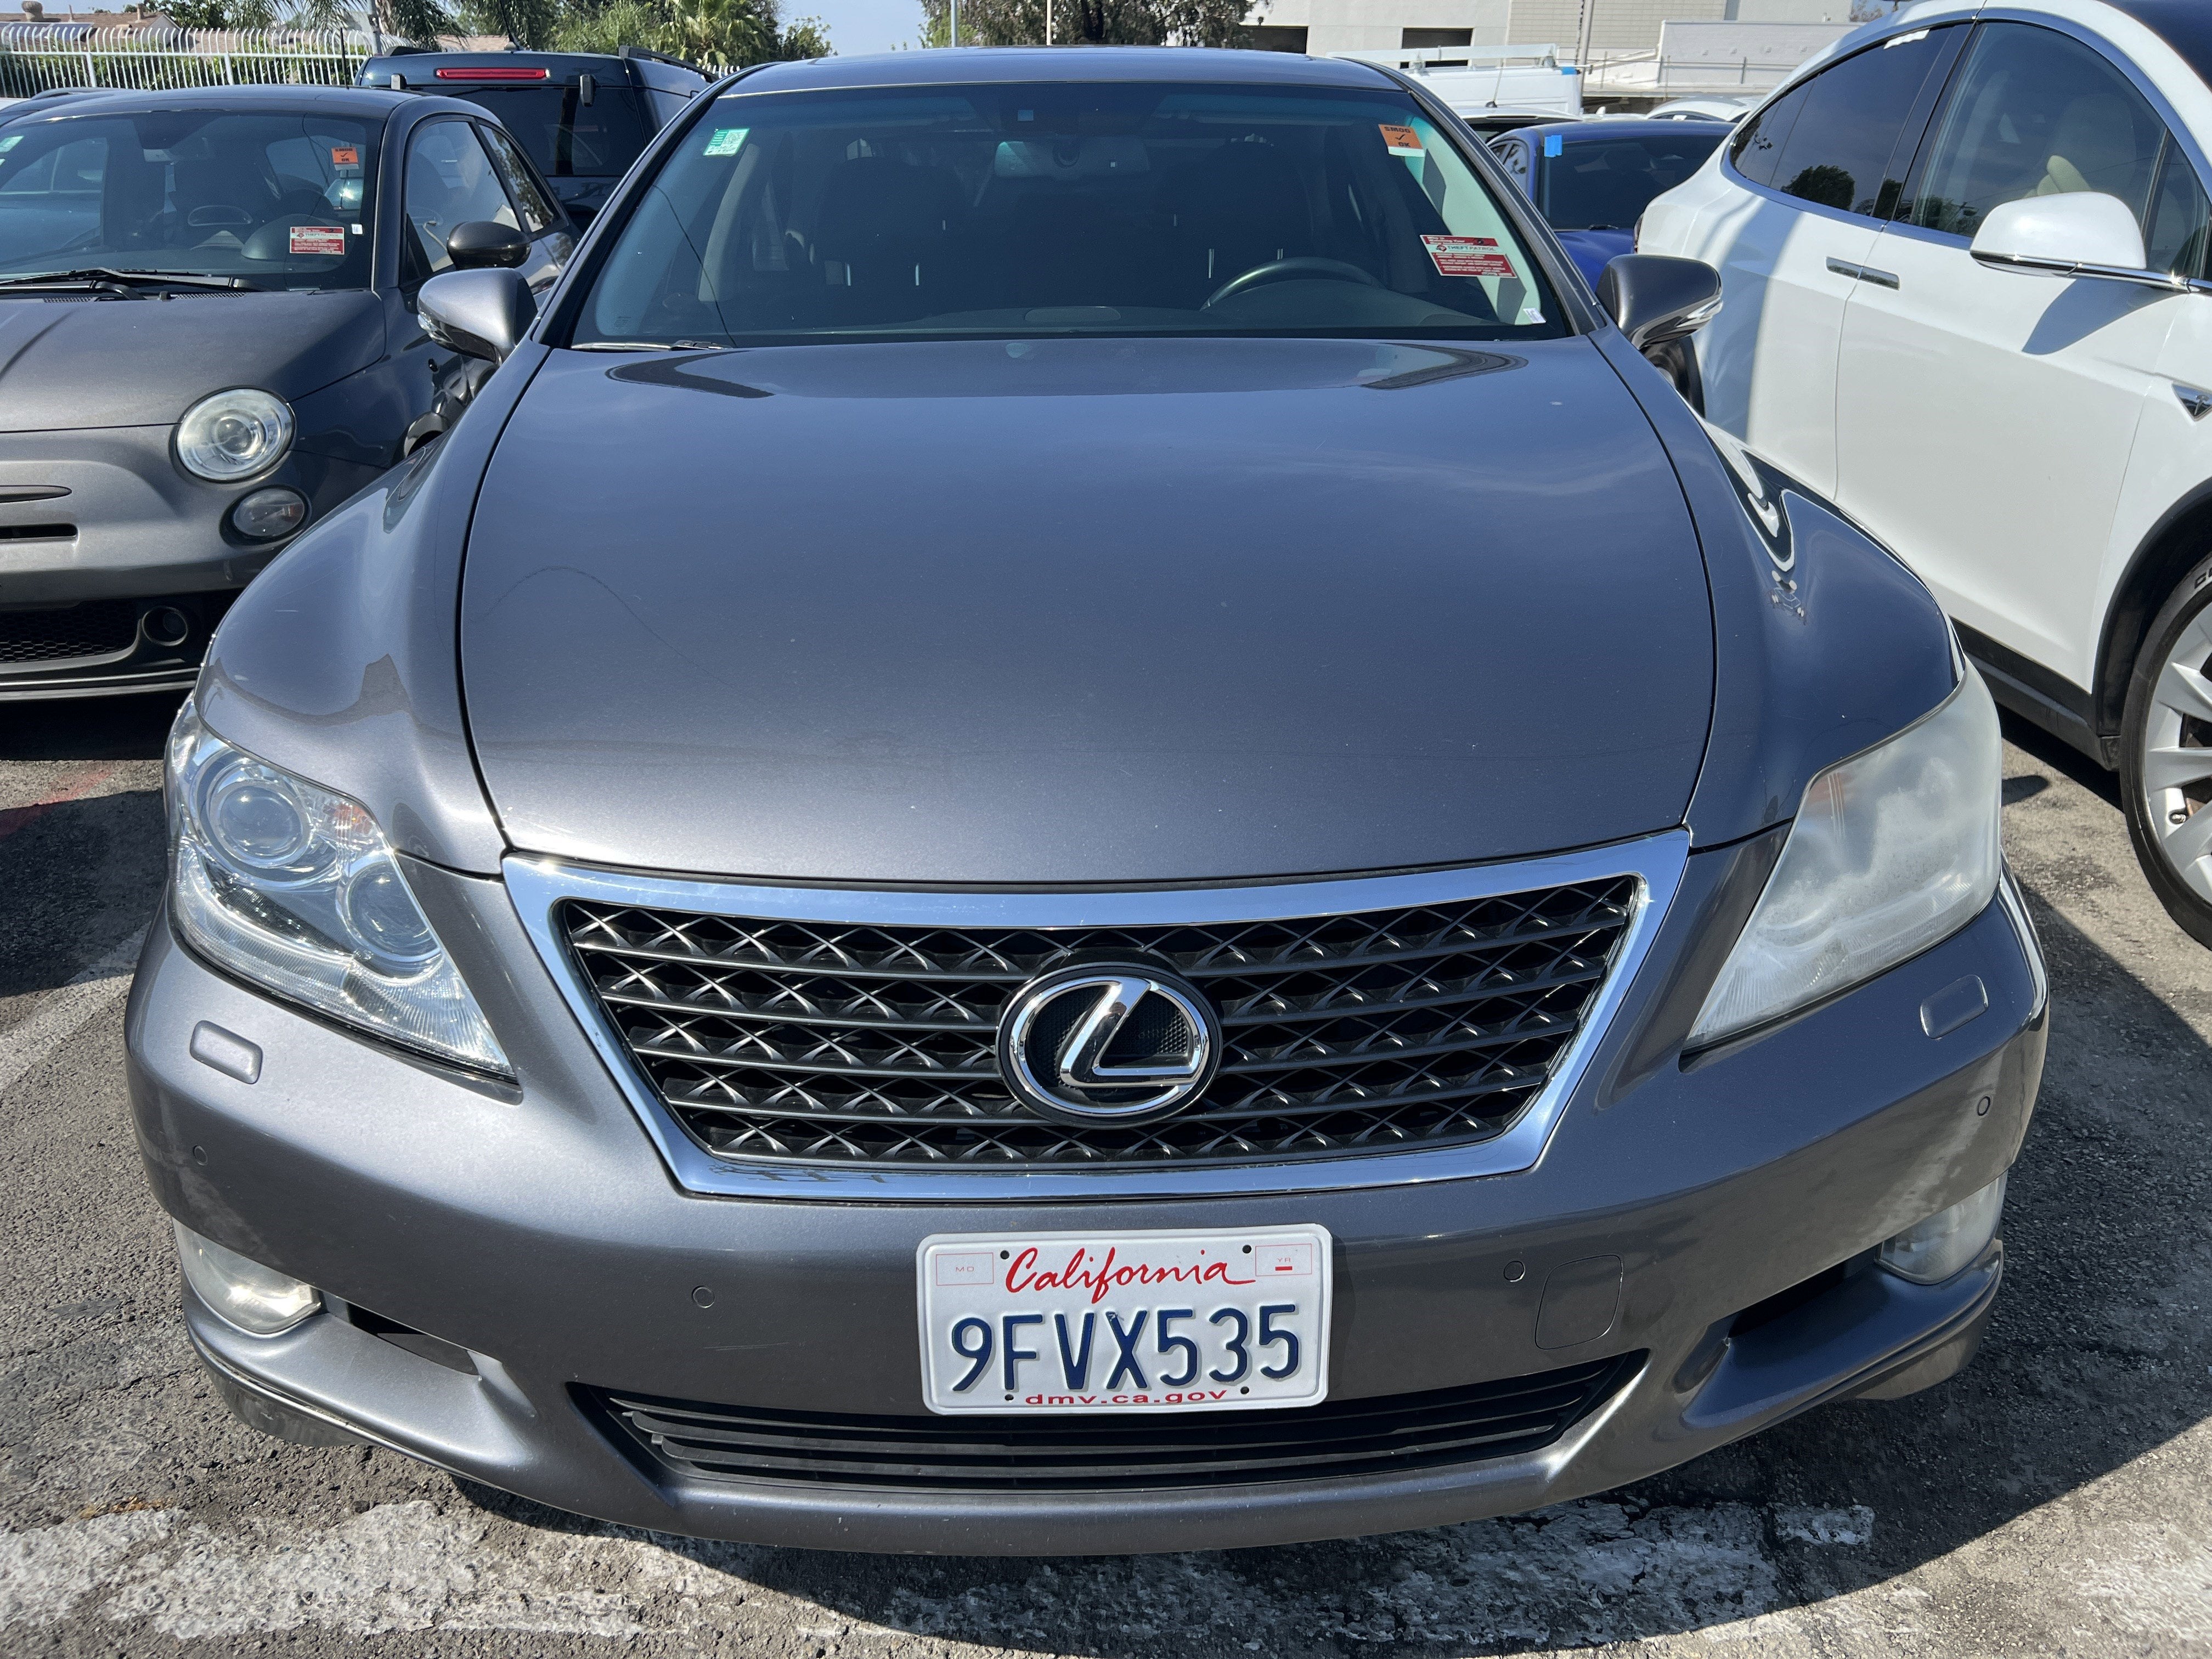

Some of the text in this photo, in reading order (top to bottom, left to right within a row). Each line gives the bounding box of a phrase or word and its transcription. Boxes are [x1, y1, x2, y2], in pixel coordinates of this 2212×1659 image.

[1006, 1247, 1255, 1304] California
[952, 1304, 1300, 1391] 9FVX535
[1025, 1390, 1227, 1404] dmv.ca.gov
